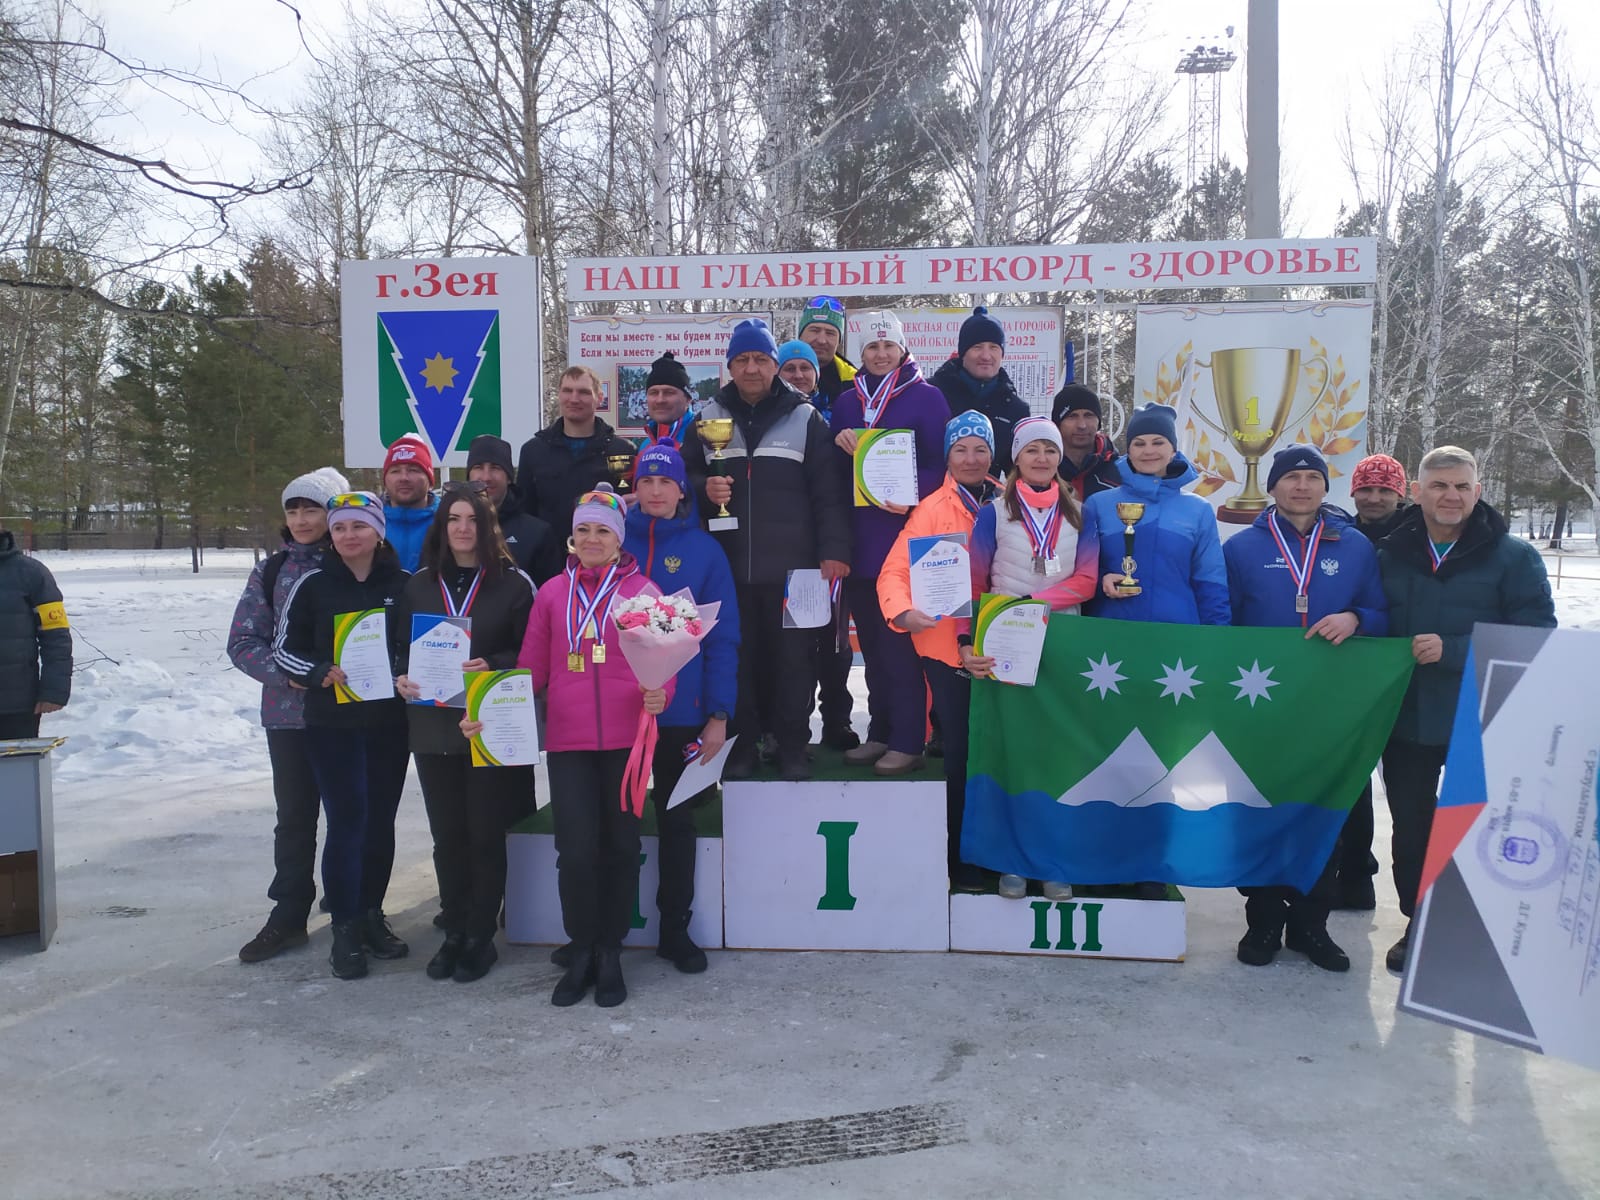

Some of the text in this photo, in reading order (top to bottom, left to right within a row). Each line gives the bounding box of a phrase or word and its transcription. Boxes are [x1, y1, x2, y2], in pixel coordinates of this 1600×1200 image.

[583, 265, 680, 291] НАШ
[701, 253, 907, 290] ГЛАВНЫЙ
[928, 254, 1093, 286] РЕКОРД
[1128, 246, 1361, 283] ЗДОРОВЬЕ
[375, 263, 499, 298] г.Зея
[1014, 320, 1057, 331] ГОРОДОВ
[580, 333, 602, 342] Если
[605, 333, 620, 342] мы
[623, 332, 655, 342] вместе
[665, 332, 680, 341] мы
[683, 331, 711, 343] будем
[714, 332, 733, 343] луч
[580, 348, 602, 358] Если
[605, 348, 620, 358] мы
[623, 348, 655, 357] вместе
[665, 347, 680, 357] мы
[683, 346, 711, 359] будем
[714, 347, 728, 356] пе
[1245, 396, 1260, 425] 1
[921, 557, 959, 569] ГРАМОТА
[421, 641, 459, 649] ГРАМОТА
[1029, 900, 1103, 951] III
